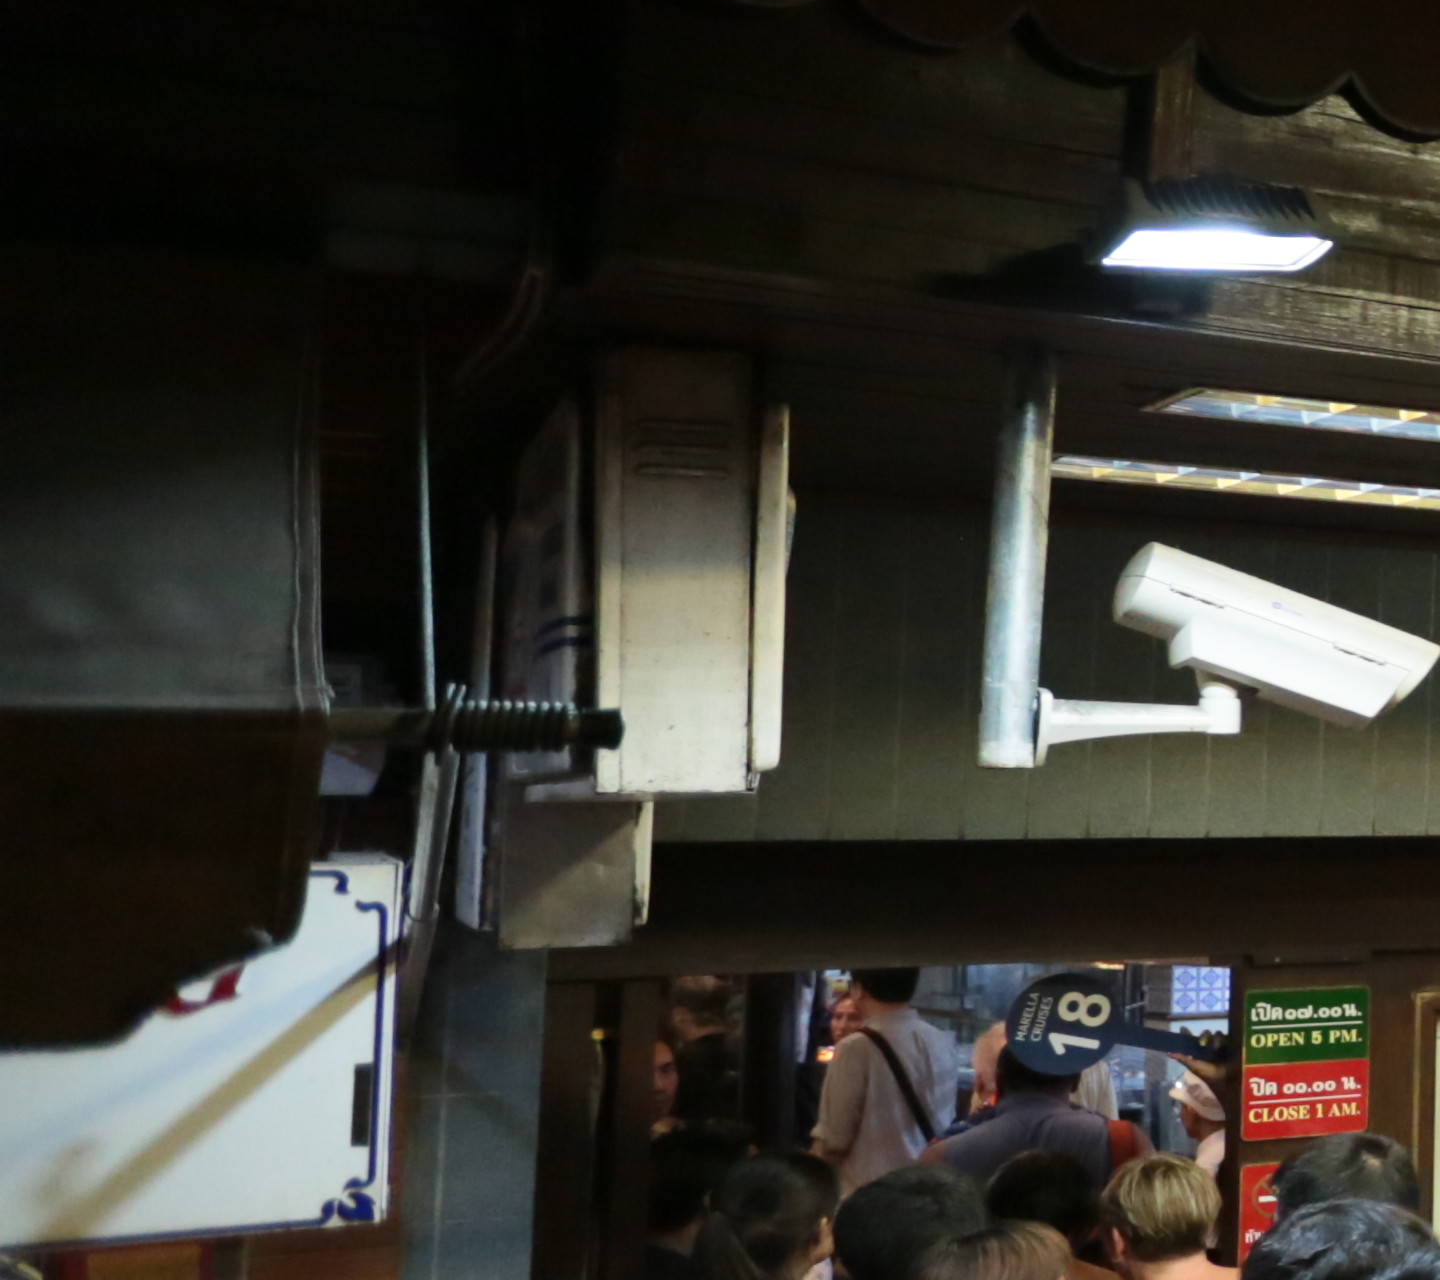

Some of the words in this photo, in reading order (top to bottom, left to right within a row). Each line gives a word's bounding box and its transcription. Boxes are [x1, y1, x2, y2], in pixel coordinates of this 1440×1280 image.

[1014, 992, 1040, 1042] MARELLA
[1030, 996, 1054, 1042] CRUISES
[1048, 991, 1112, 1055] 18
[1250, 1031, 1306, 1048] OPEN
[1311, 1030, 1323, 1045] 5
[1328, 1028, 1363, 1044] PM.
[1248, 1104, 1311, 1124] CLOSE
[1315, 1103, 1324, 1118] 1
[1327, 1102, 1361, 1118] AM.
